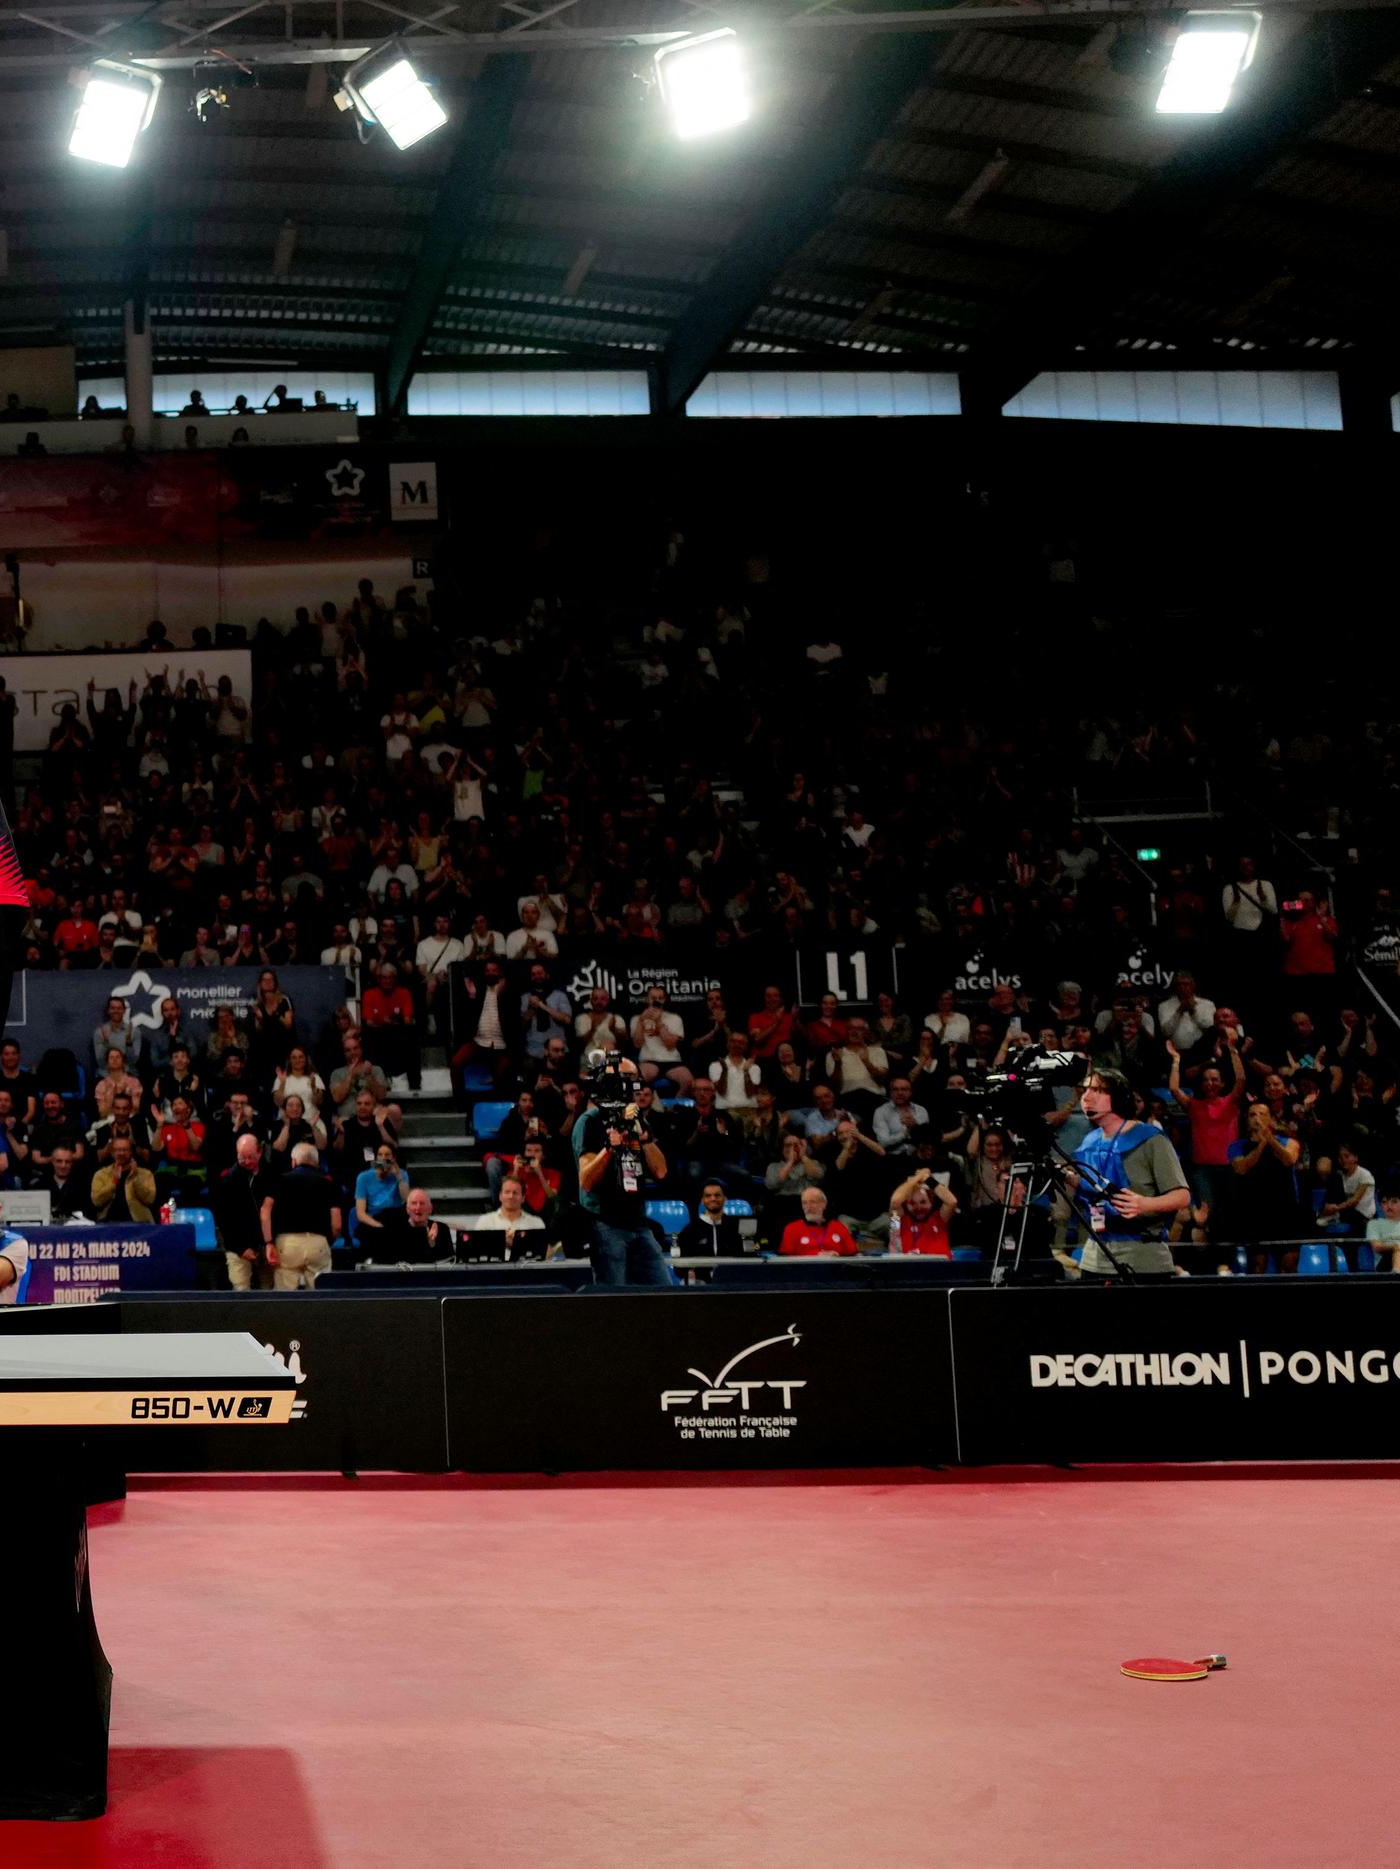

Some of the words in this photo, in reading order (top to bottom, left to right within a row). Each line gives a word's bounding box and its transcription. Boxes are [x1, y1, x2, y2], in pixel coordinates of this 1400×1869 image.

[402, 481, 428, 504] M
[416, 561, 430, 576] R
[825, 950, 869, 1001] L1
[39, 1243, 54, 1259] 22
[55, 1243, 70, 1259] AU
[72, 1242, 87, 1259] 24
[88, 1241, 119, 1258] MARS
[122, 1241, 150, 1257] 2024
[72, 1264, 120, 1281] STADIUM
[1029, 1352, 1231, 1388] DECATHLON
[1259, 1349, 1400, 1385] PONG
[660, 1380, 807, 1412] FFTT
[131, 1397, 235, 1419] 850-W
[674, 1415, 737, 1428] Fédération
[739, 1415, 798, 1428] Française
[680, 1428, 696, 1439] de
[699, 1428, 737, 1439] Tennis
[740, 1428, 756, 1439] de
[759, 1427, 791, 1438] Table
